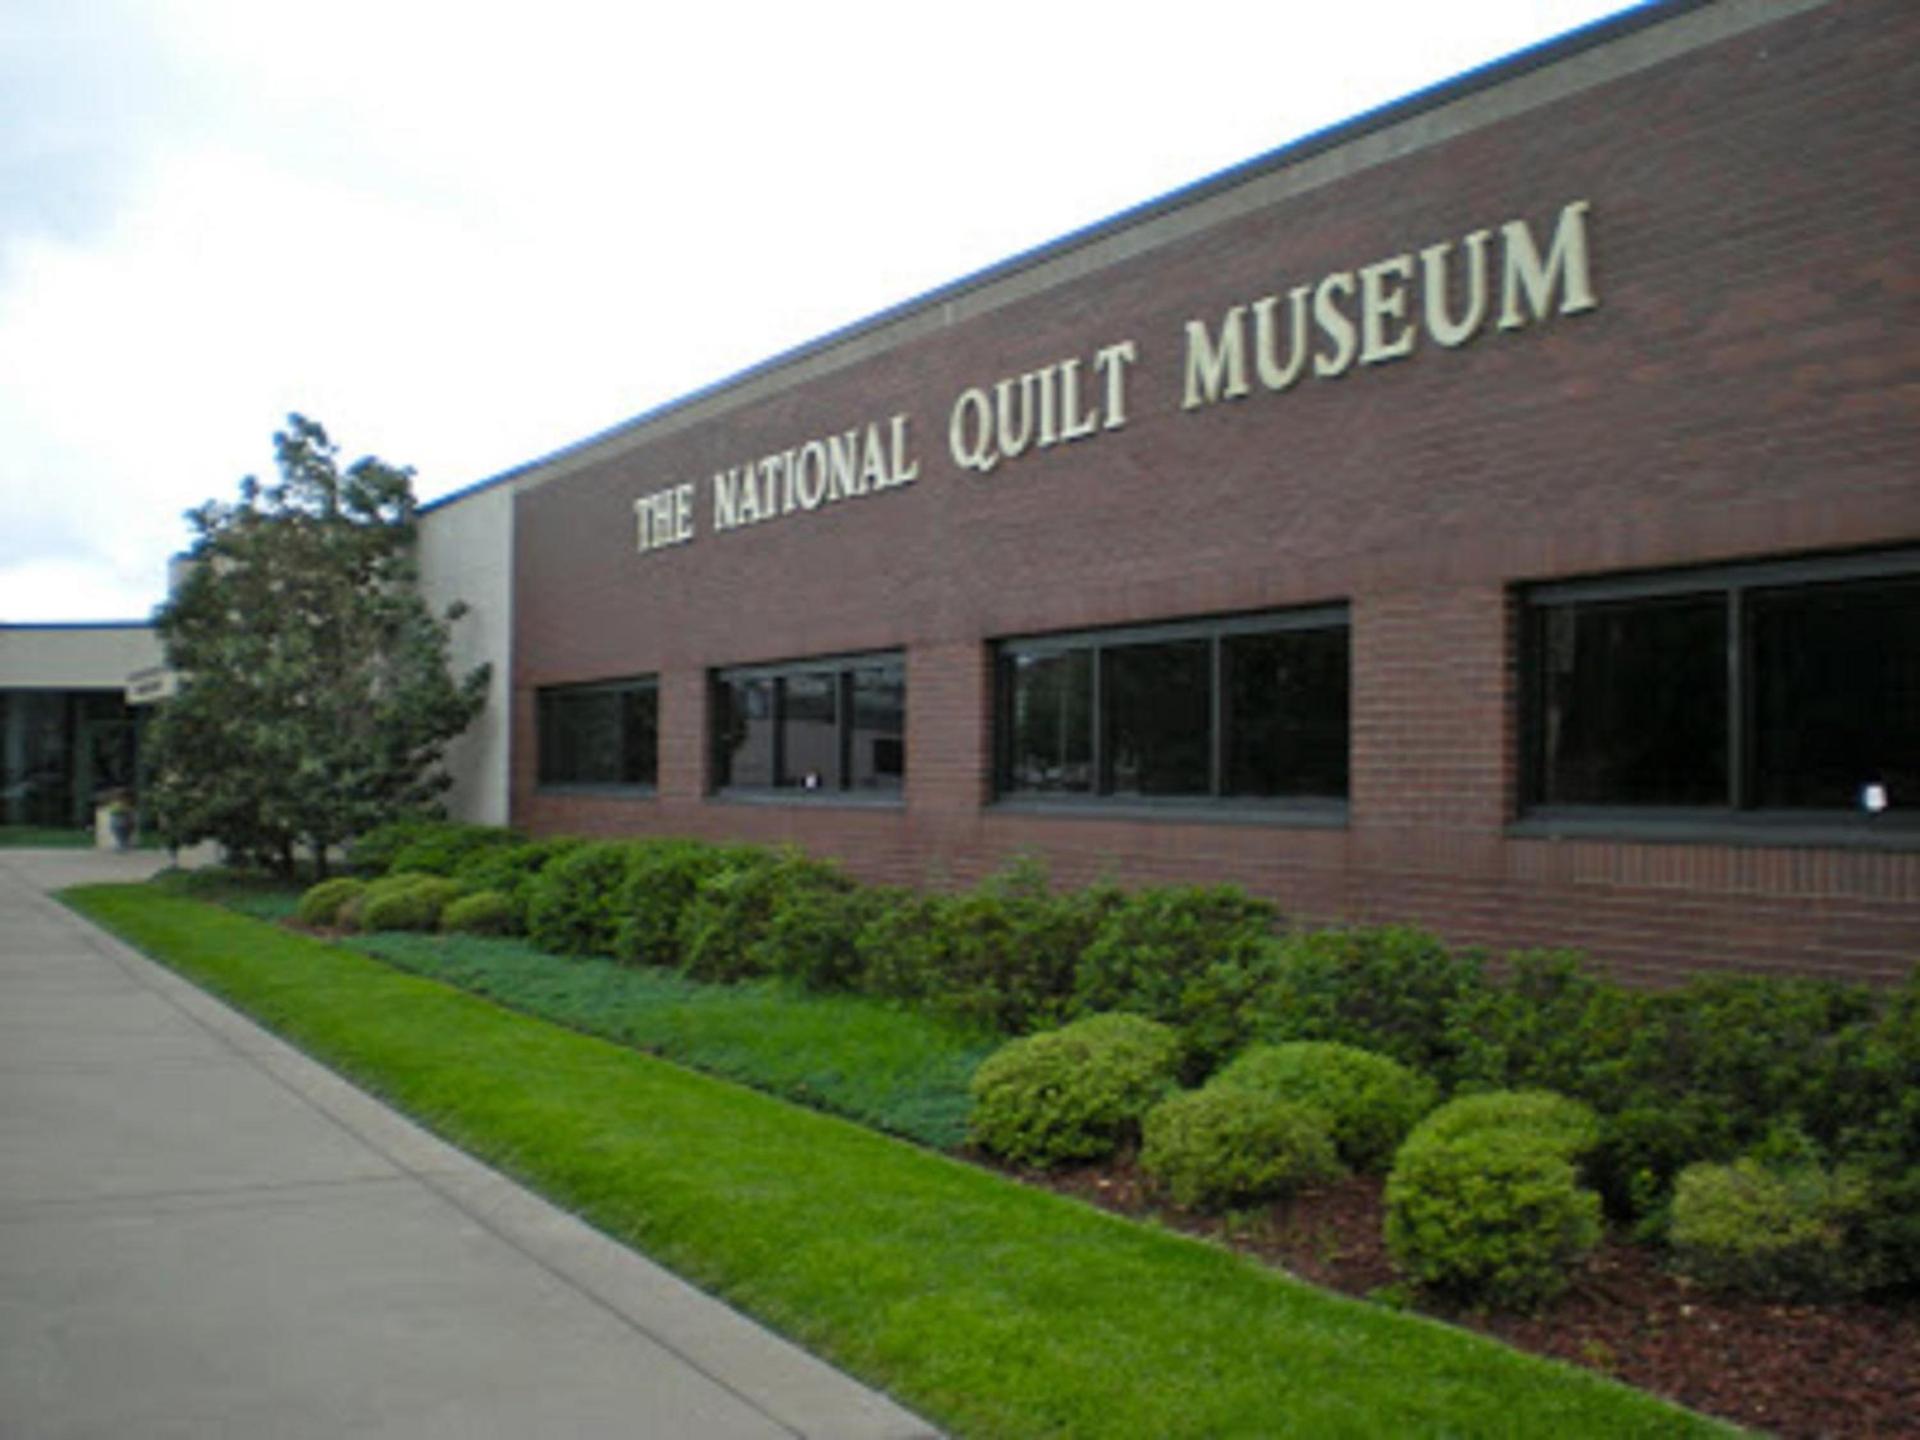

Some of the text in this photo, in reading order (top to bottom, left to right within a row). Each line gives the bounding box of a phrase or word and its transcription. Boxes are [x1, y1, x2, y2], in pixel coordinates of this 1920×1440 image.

[634, 201, 1597, 552] THE NATIONAL QUILT MUSEUM
